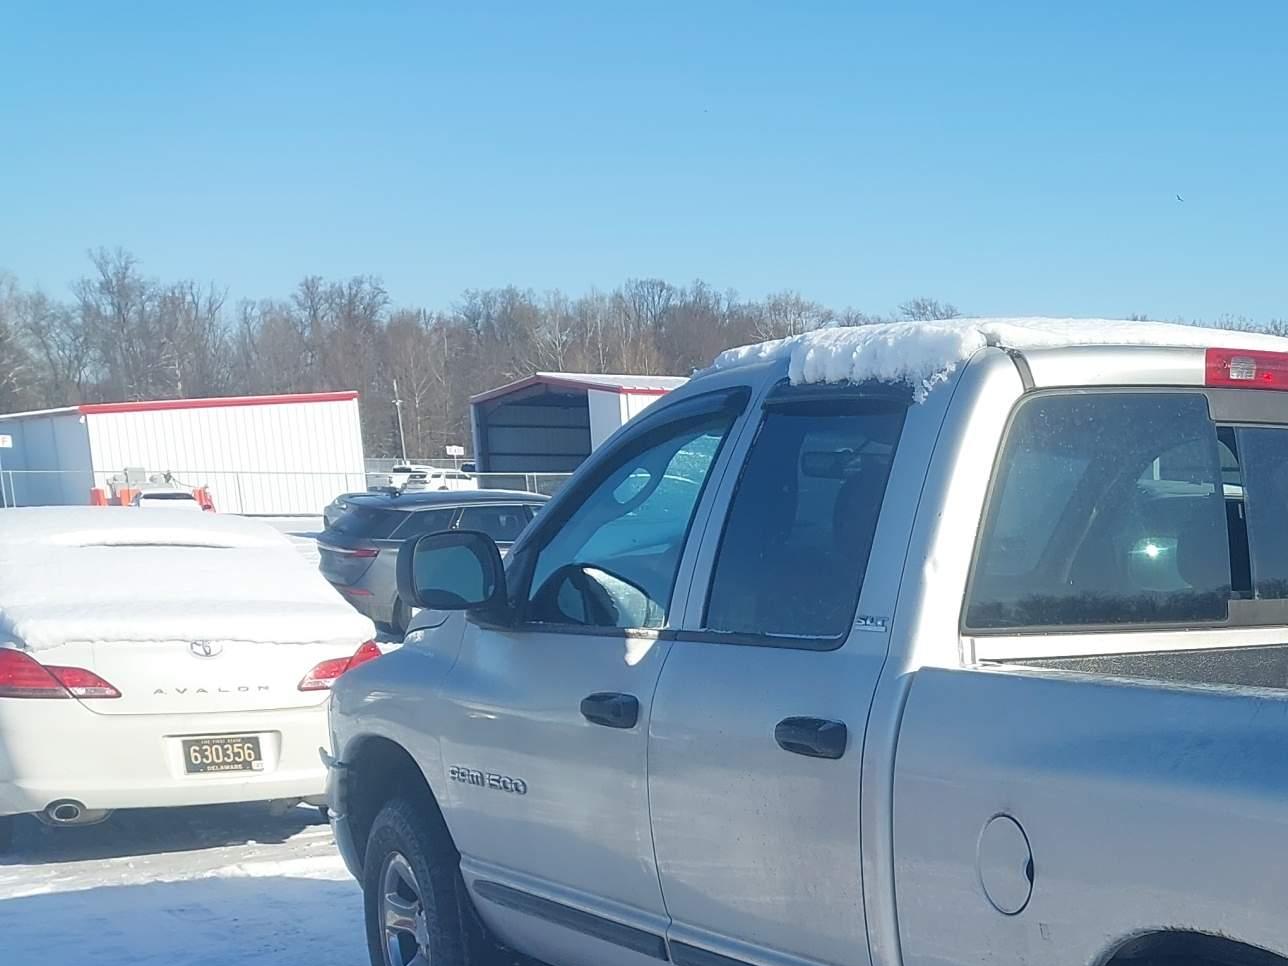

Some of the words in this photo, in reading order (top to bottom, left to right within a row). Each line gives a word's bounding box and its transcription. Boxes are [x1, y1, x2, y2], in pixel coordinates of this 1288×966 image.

[152, 685, 270, 695] AVALON
[189, 743, 255, 764] 630356
[206, 763, 243, 771] DELAWARE
[485, 770, 528, 796] 1500
